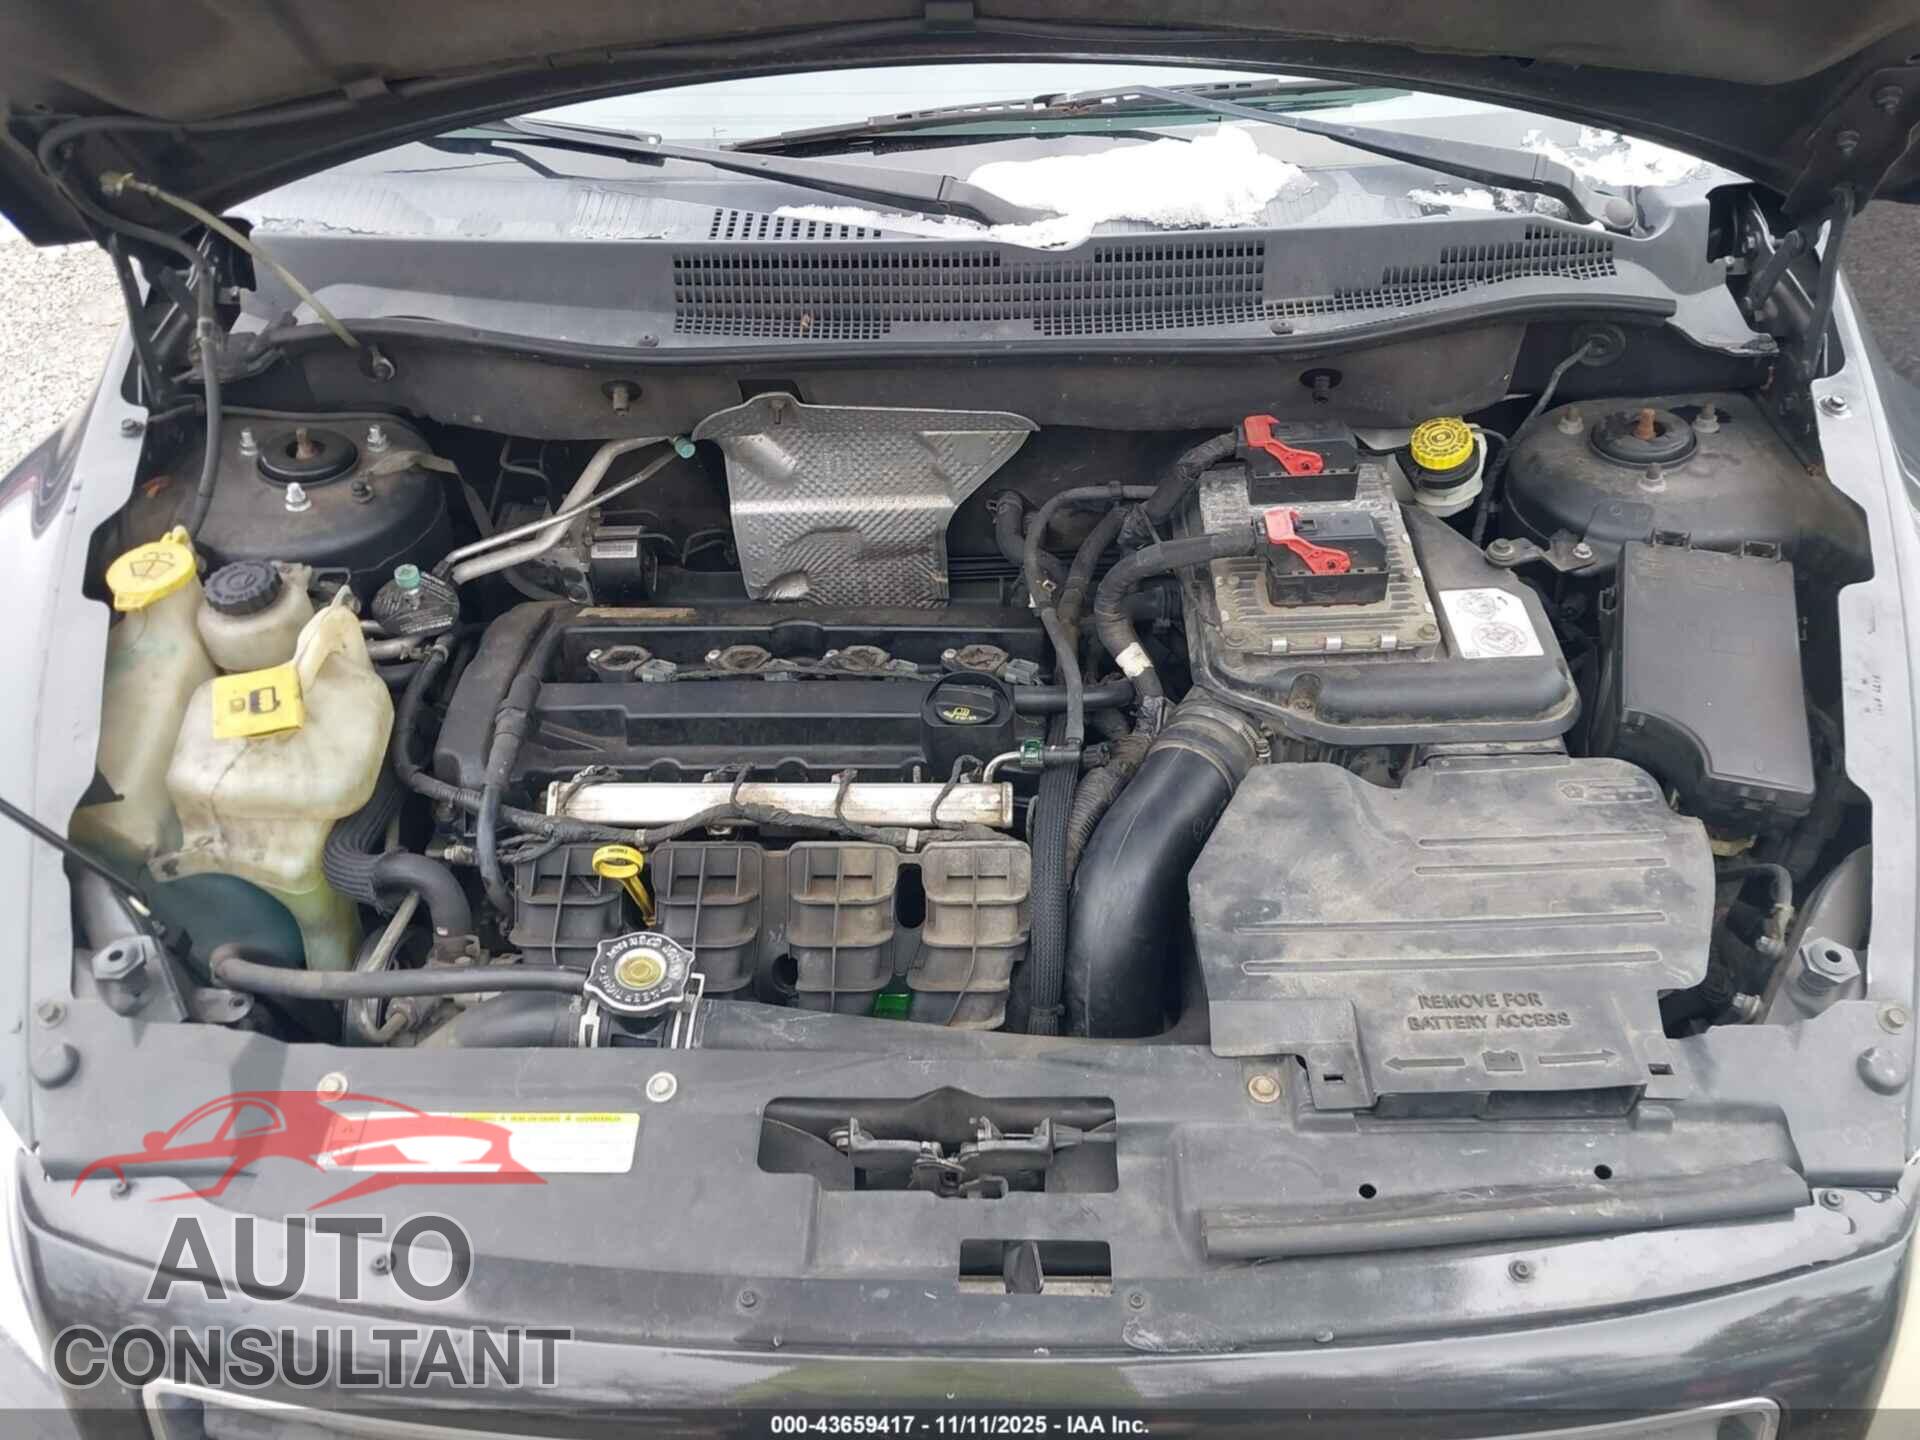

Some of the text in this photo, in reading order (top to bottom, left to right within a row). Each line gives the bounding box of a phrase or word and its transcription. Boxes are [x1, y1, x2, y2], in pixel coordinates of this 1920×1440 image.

[1418, 991, 1543, 1009] REMOVE FOR
[1407, 1010, 1572, 1032] BATTERY ACCESS
